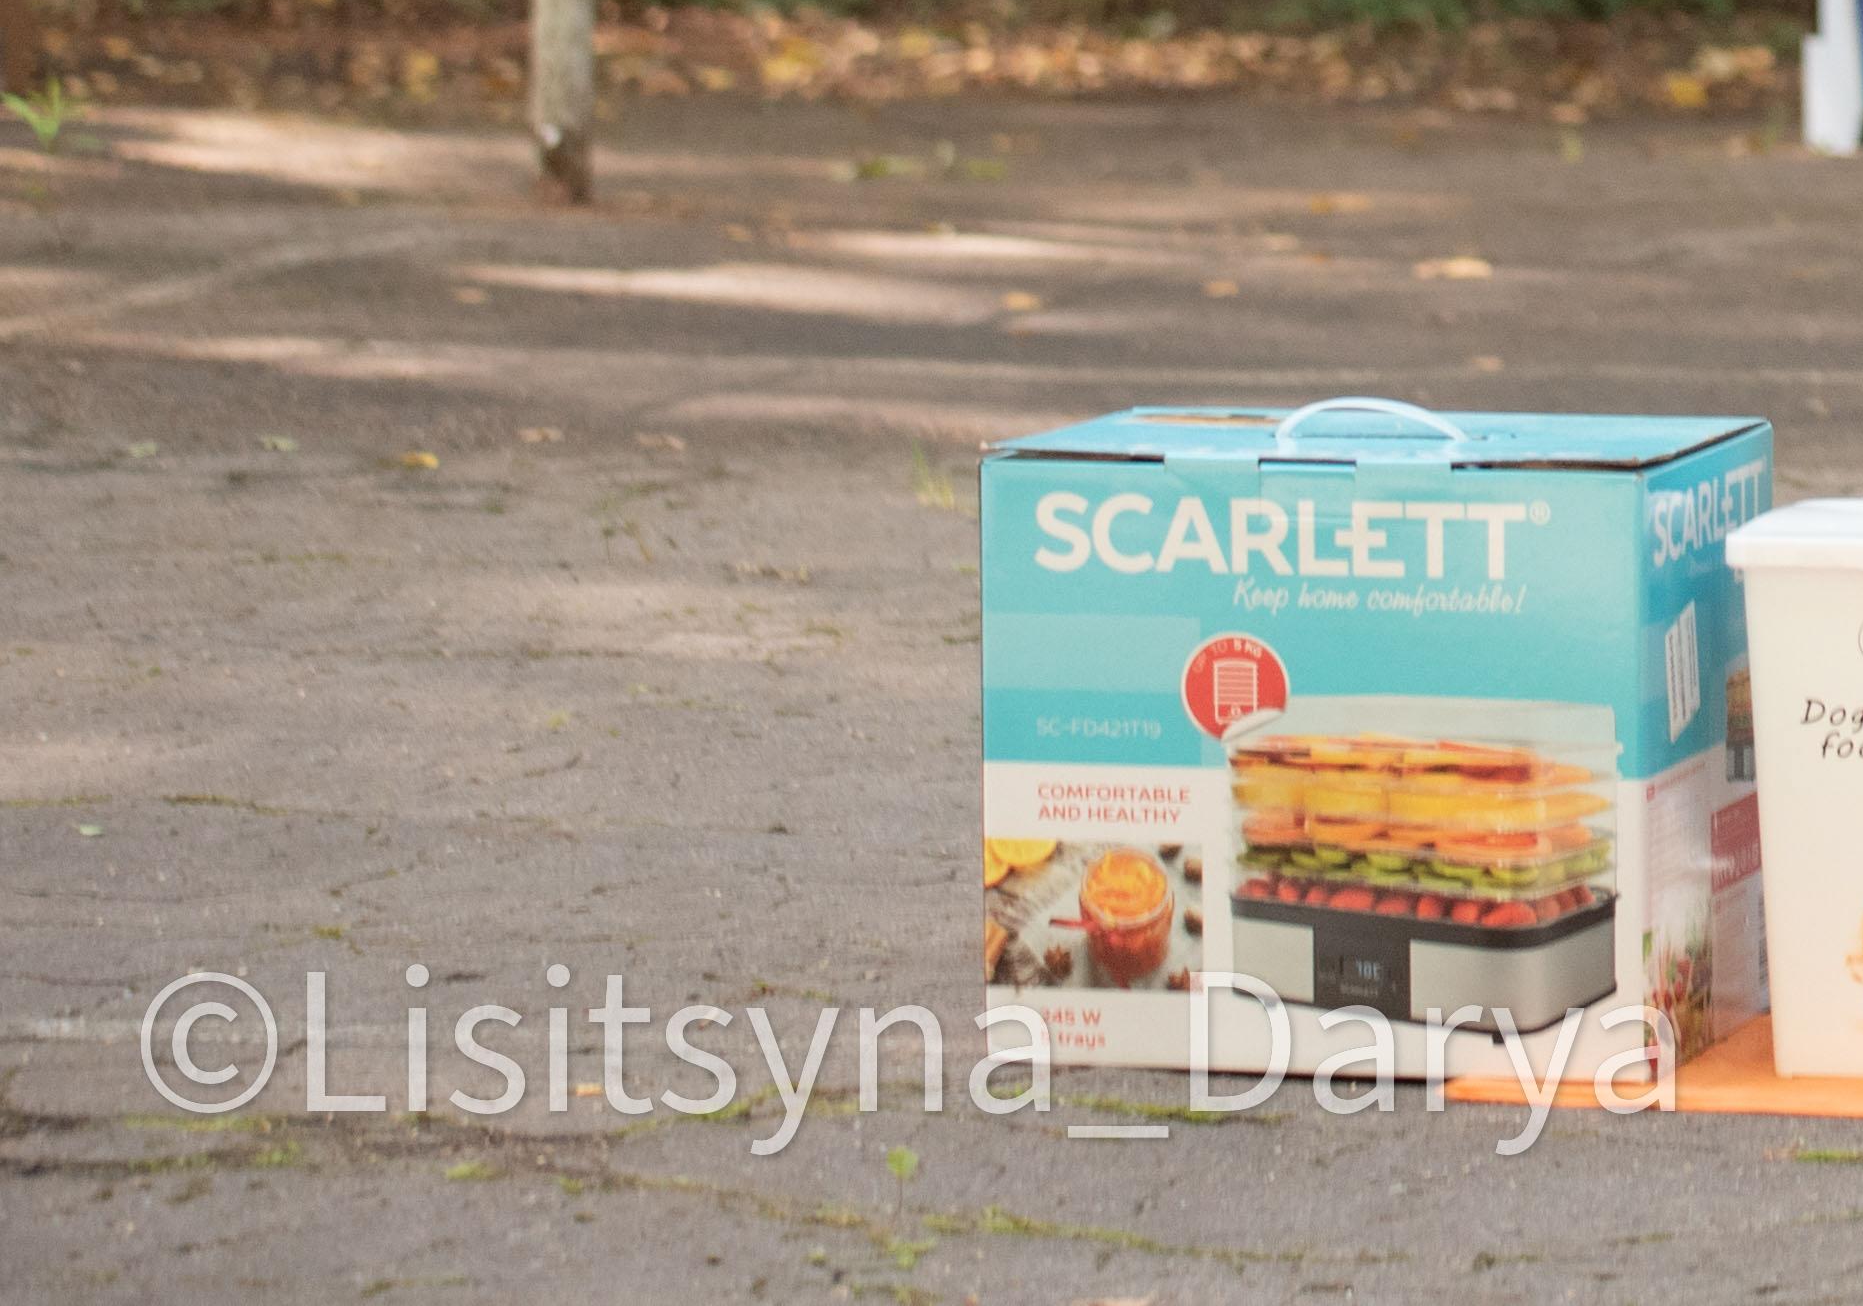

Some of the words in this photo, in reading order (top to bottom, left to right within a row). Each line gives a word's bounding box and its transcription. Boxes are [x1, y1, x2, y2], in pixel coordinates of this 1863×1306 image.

[1653, 461, 1764, 569] SCARLETT
[1232, 576, 1289, 617] Keep
[1296, 580, 1360, 611] home
[1366, 582, 1528, 619] comfortable!
[1036, 783, 1192, 805] COMFORTABLE
[1037, 804, 1081, 822] AND
[1087, 806, 1182, 826] HEALTHY
[1081, 1007, 1102, 1027] W
[1057, 1030, 1106, 1051] trays
